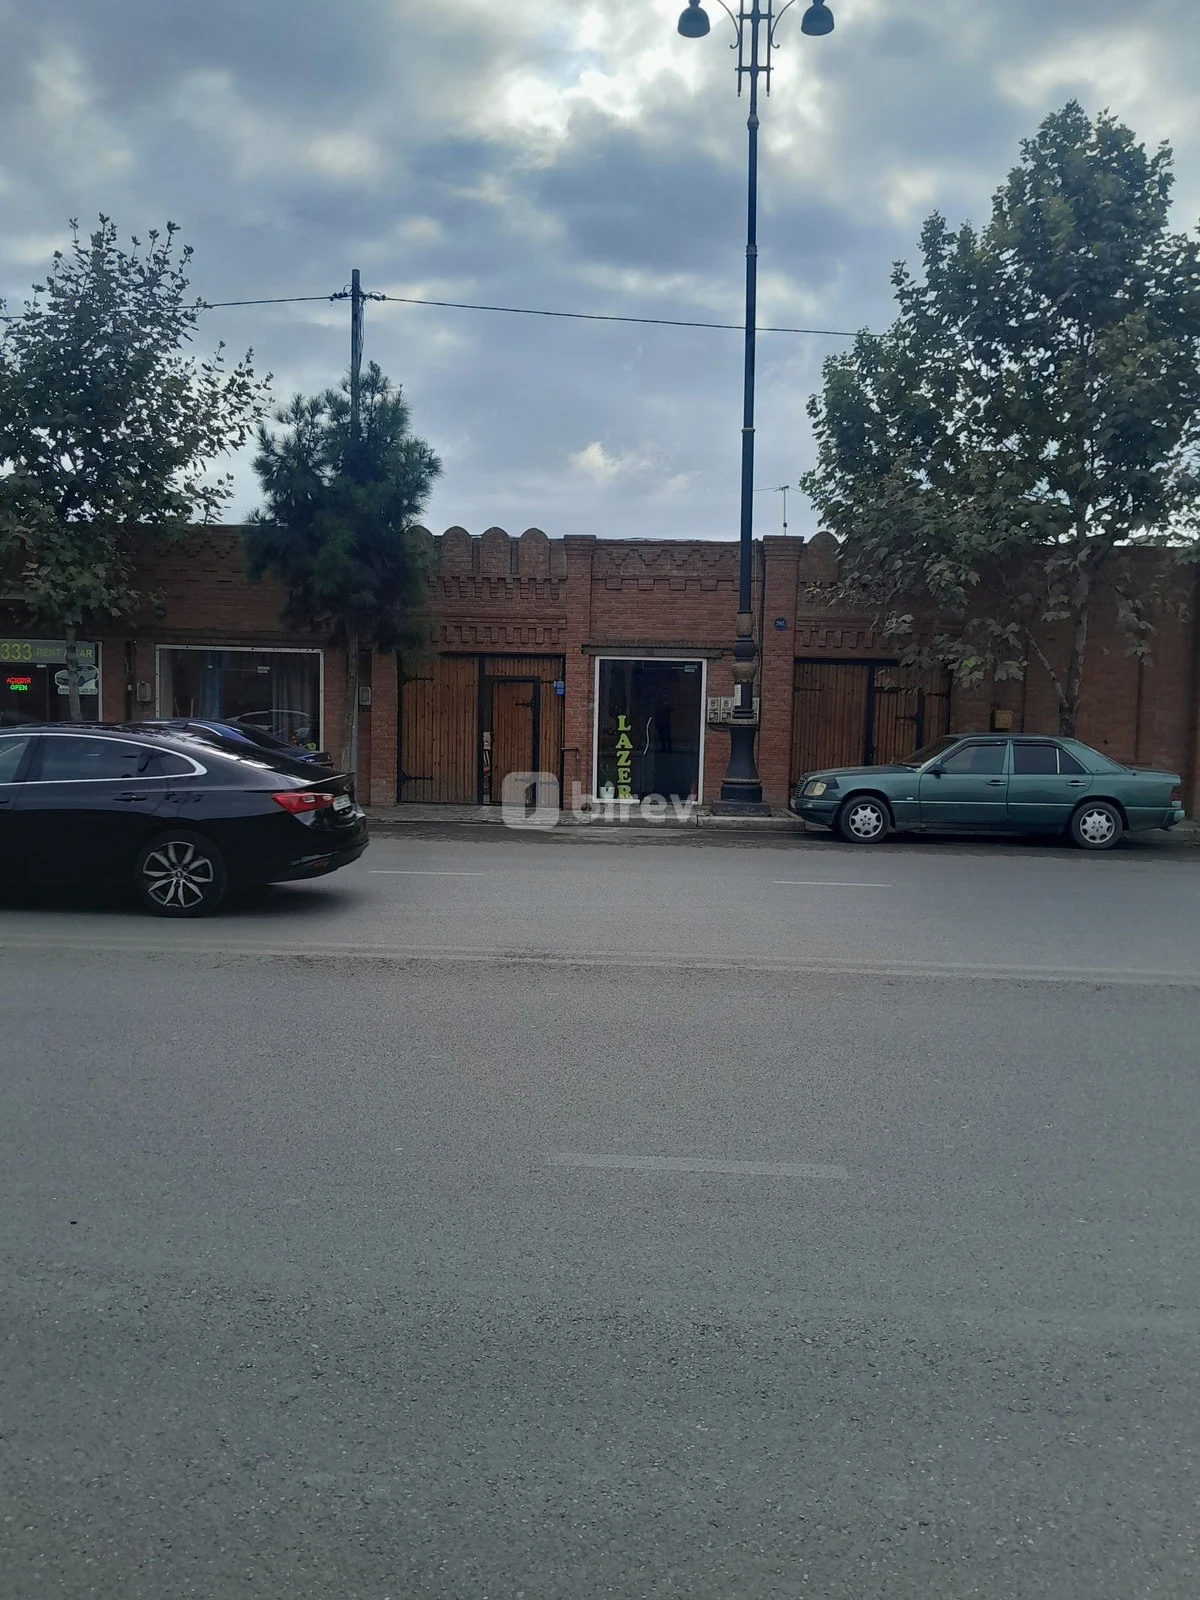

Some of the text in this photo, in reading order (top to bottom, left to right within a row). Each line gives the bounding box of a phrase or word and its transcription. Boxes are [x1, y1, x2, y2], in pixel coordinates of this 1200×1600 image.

[1, 642, 32, 661] 333
[36, 648, 61, 657] RENT
[76, 648, 93, 658] AR
[615, 714, 634, 800] LAZER
